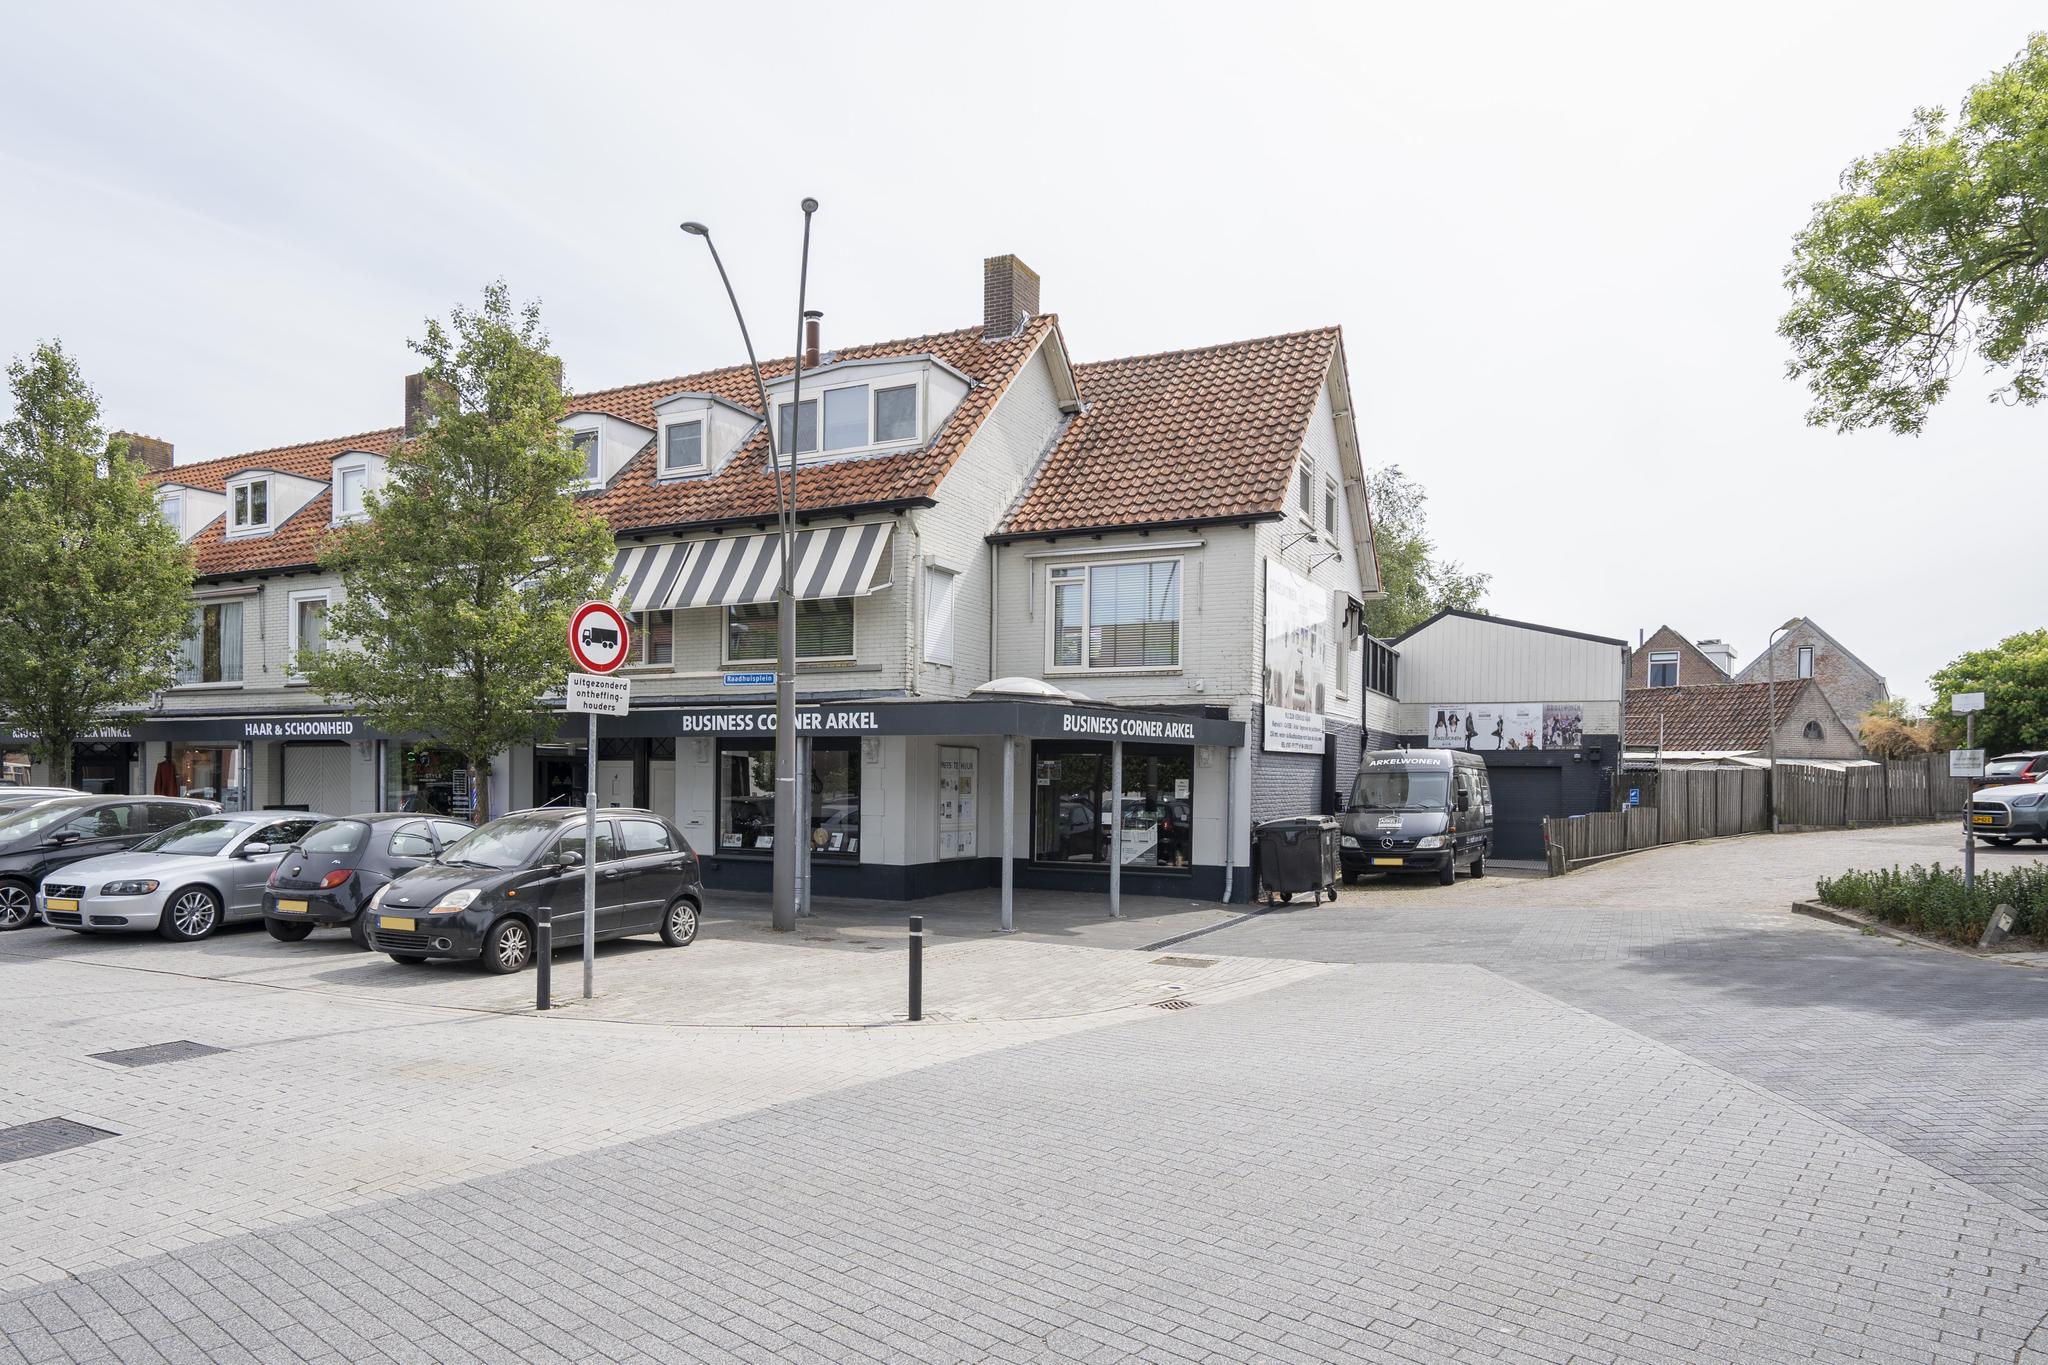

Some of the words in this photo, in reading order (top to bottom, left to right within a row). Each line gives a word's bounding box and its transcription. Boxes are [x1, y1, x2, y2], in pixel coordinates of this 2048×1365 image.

[573, 677, 628, 690] uitgezonderd
[726, 674, 773, 684] Raadhuisplein
[576, 689, 623, 703] ontheffing-
[583, 700, 616, 711] houders
[682, 714, 754, 731] BUSINESS
[757, 713, 822, 731] CONER
[825, 712, 879, 730] ARKEL
[1063, 714, 1119, 735] BUSINESS
[1120, 719, 1163, 737] CORNER
[1164, 722, 1195, 738] ARKEL
[245, 723, 273, 736] HAAR
[275, 724, 283, 735] &
[285, 721, 354, 735] SCHOONHEID
[1369, 758, 1441, 767] ARKELWONEN
